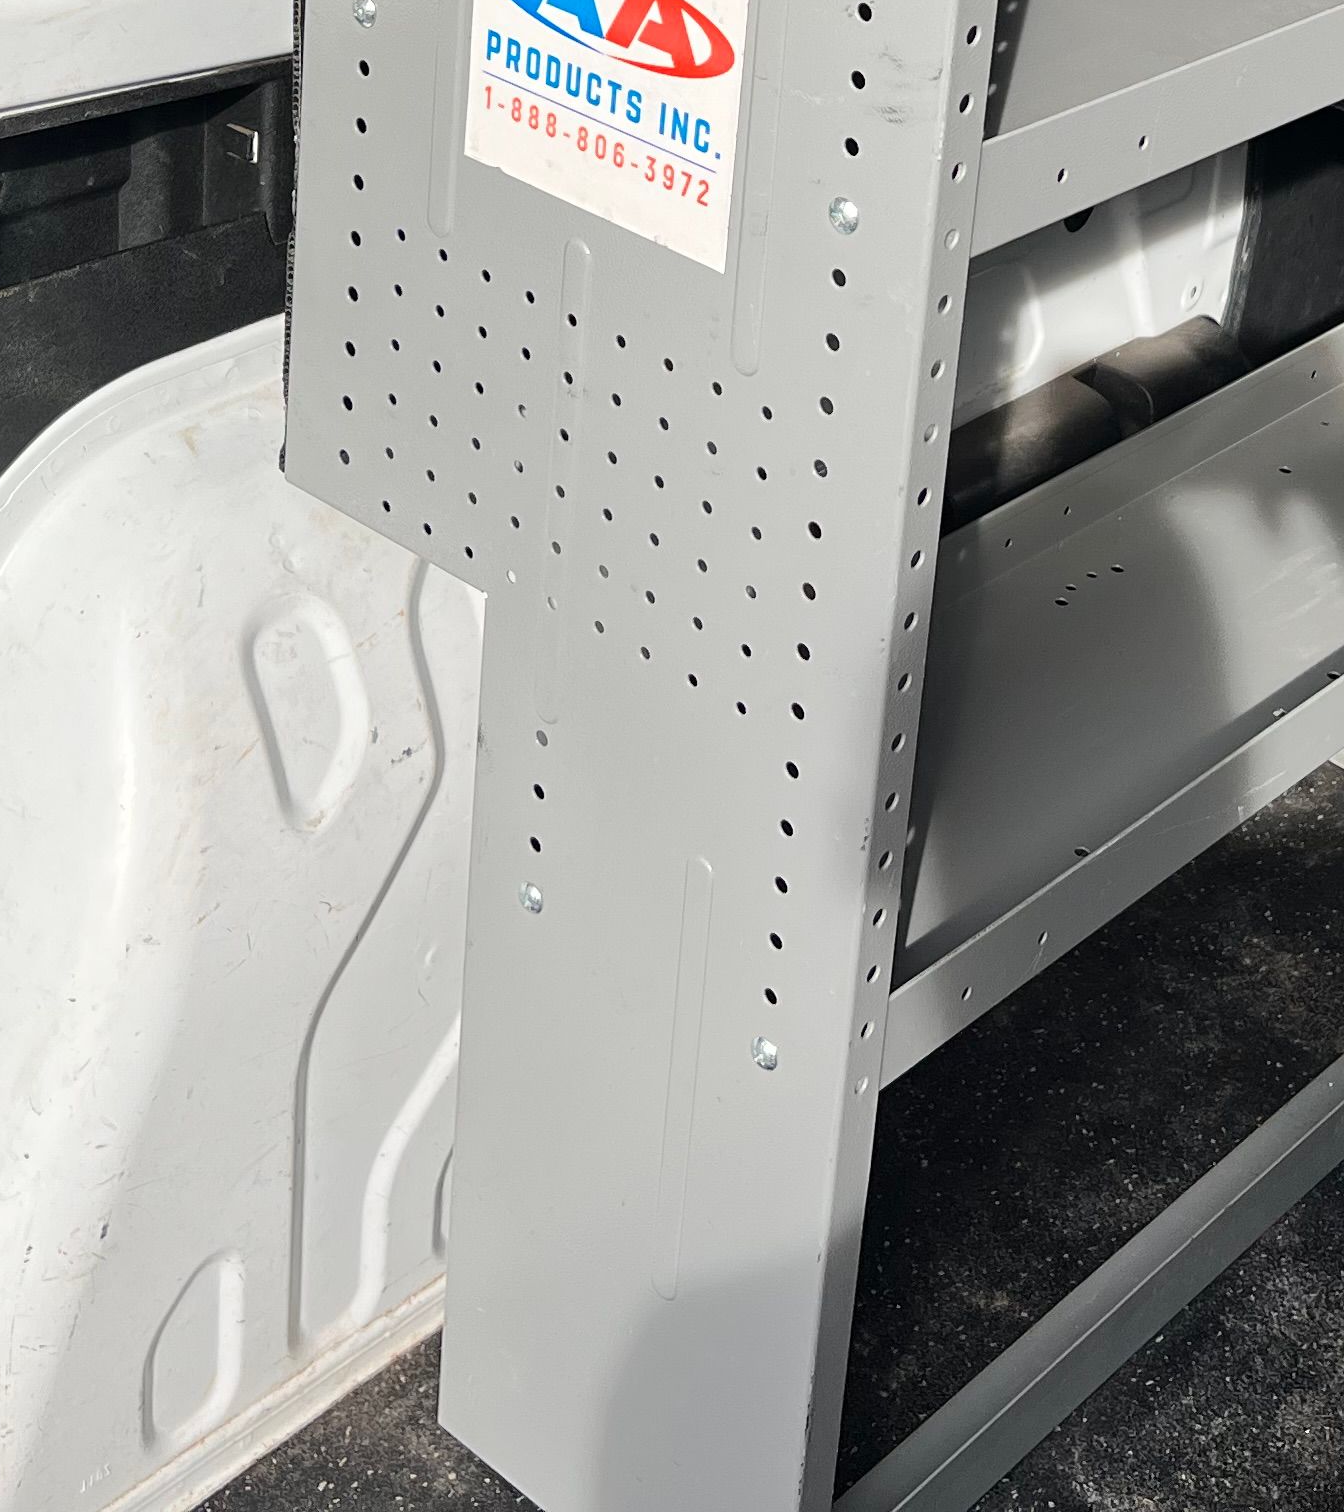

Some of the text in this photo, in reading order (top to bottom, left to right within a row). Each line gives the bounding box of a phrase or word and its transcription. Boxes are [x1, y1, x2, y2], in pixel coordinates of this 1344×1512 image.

[484, 85, 709, 207] 1-888-806-3972
[486, 29, 722, 160] PRODUCTS INC.
